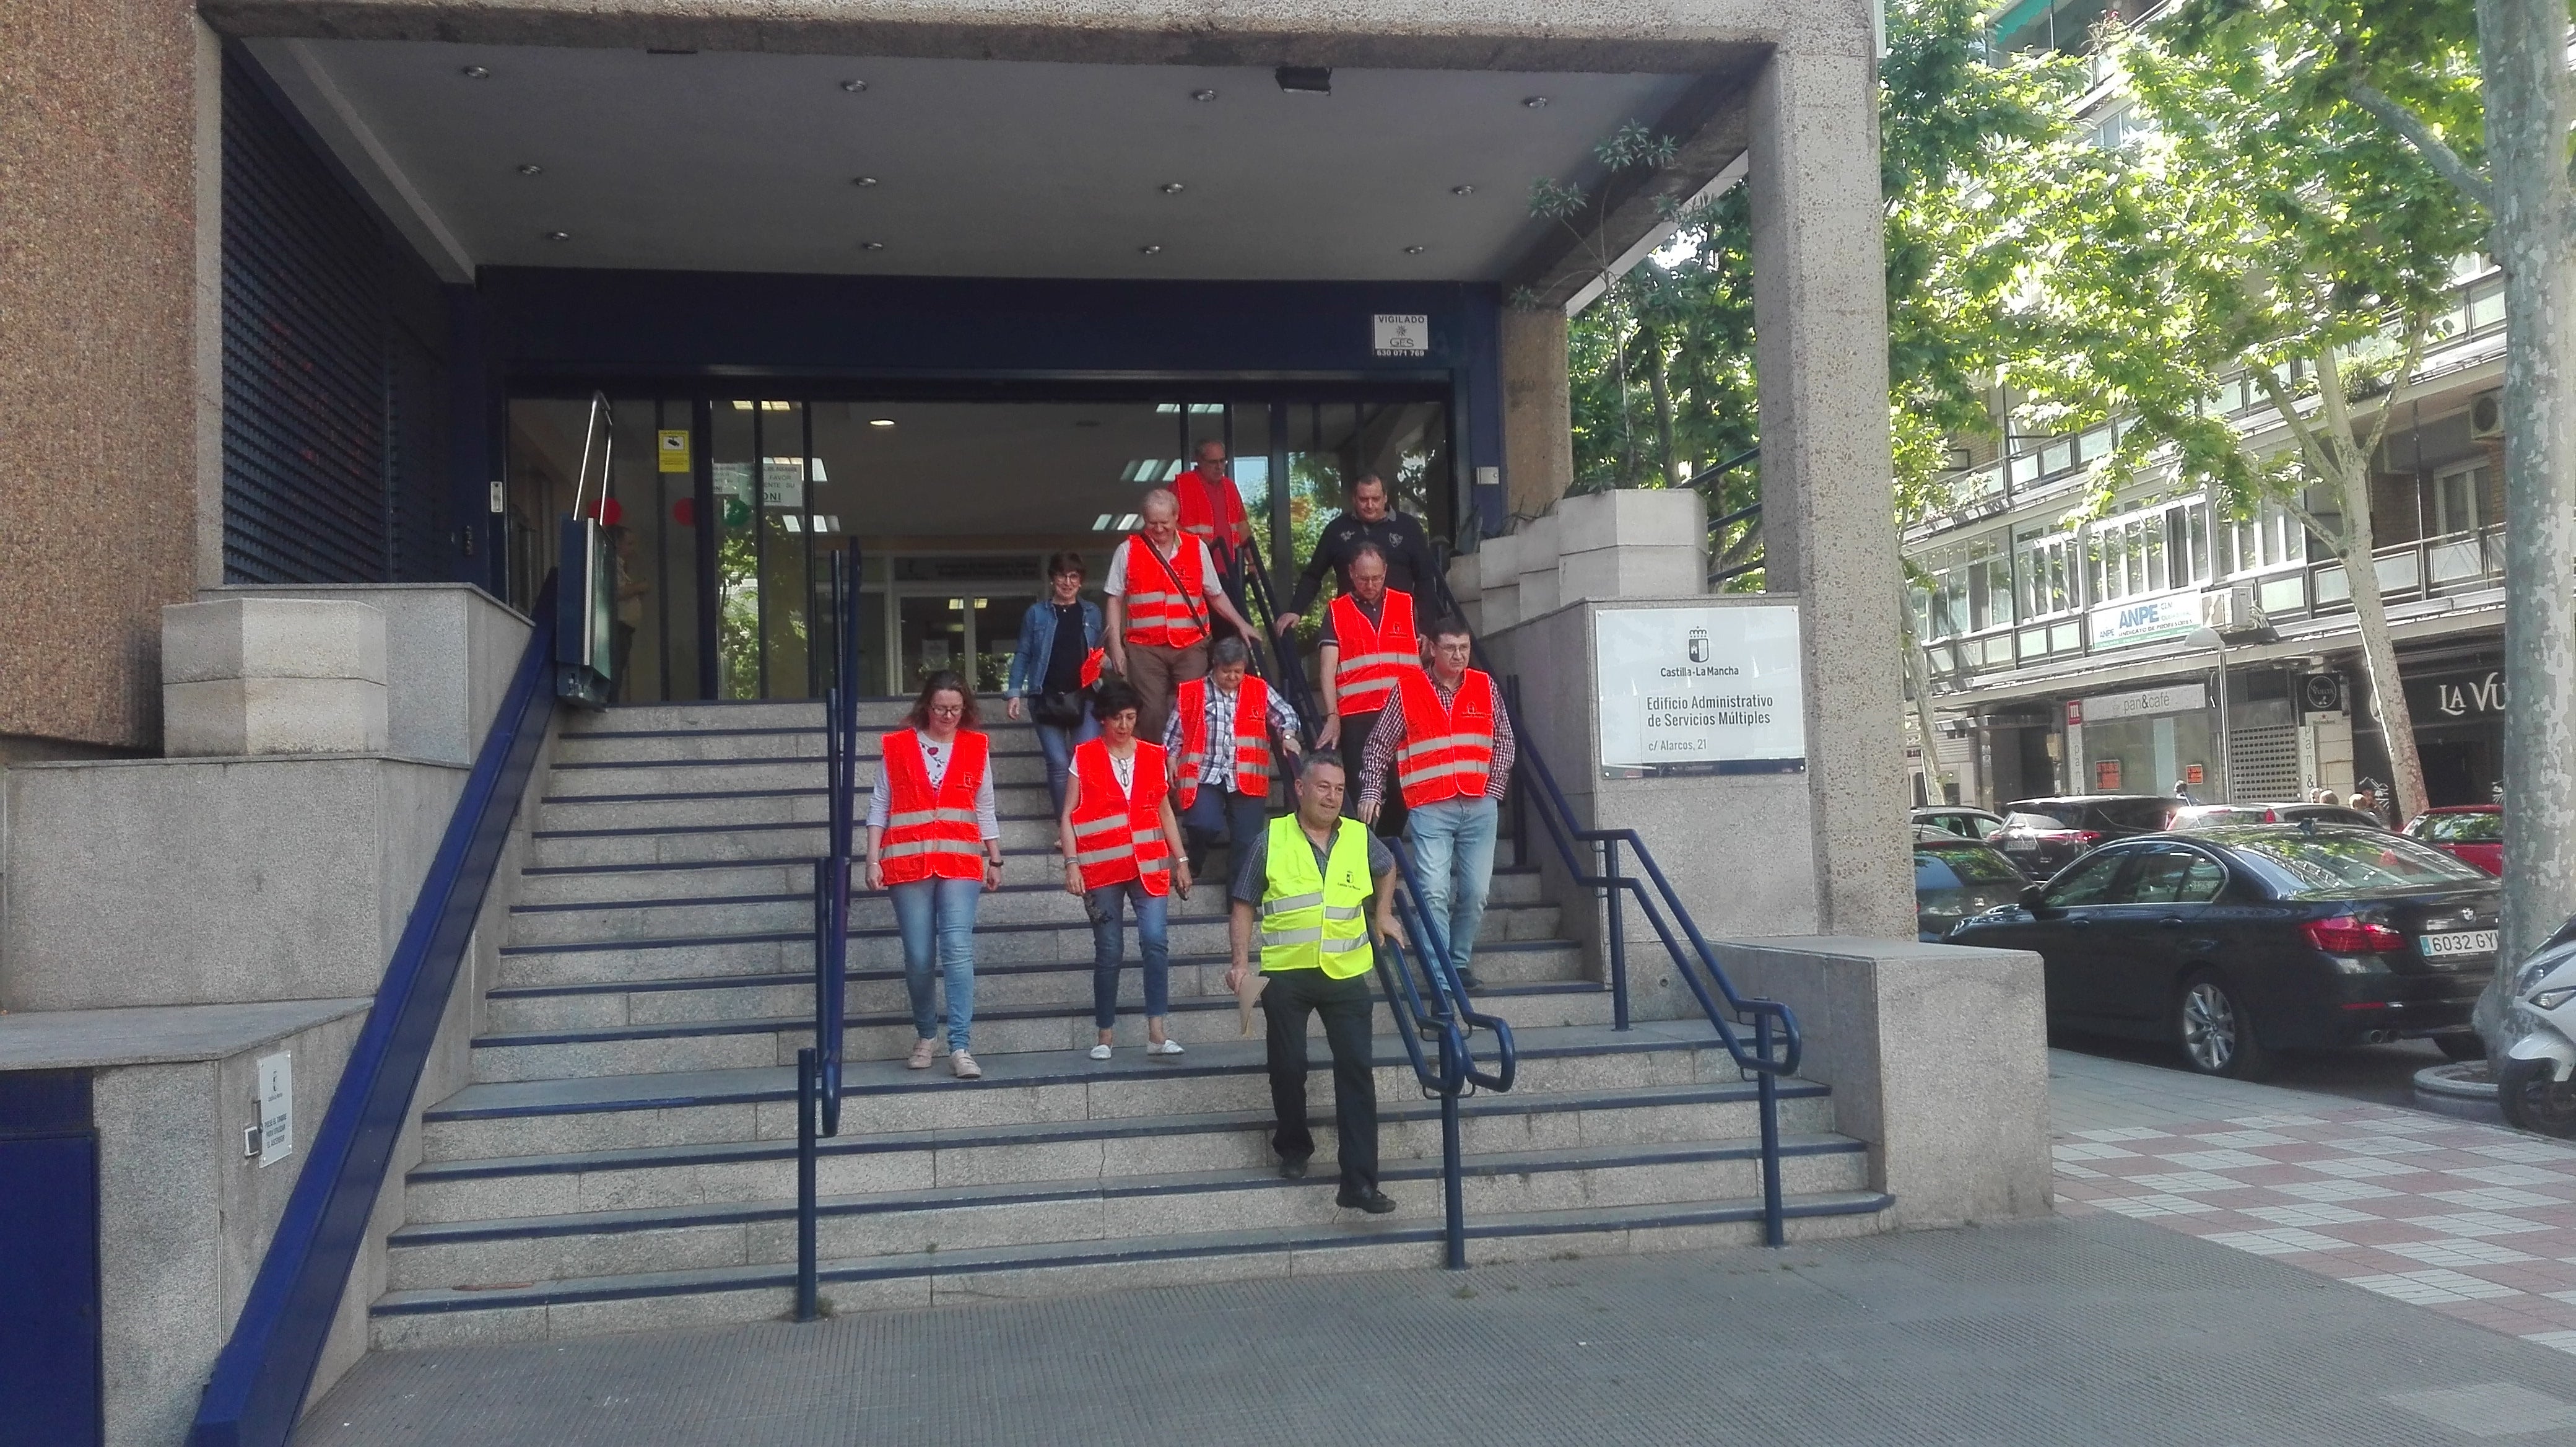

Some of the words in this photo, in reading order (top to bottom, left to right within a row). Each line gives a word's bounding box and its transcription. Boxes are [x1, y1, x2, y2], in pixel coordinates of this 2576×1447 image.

[2119, 603, 2159, 629] ANPE
[2100, 628, 2115, 638] ANPE
[2118, 627, 2147, 637] SINDICATO
[2157, 619, 2193, 629] PROFESORES
[1660, 667, 1706, 677] Castilla-La
[1707, 666, 1739, 676] Mancha
[1647, 697, 1688, 710] Edificio
[1691, 694, 1773, 709] Administrativo
[2440, 684, 2466, 715] LA
[2469, 672, 2505, 711] VU
[2124, 691, 2170, 714] pan&café
[1648, 714, 1661, 728] de
[1664, 713, 1715, 727] Servicios
[1718, 710, 1770, 725] Múltiples
[1648, 740, 1658, 751] c/
[1661, 740, 1695, 751] Alarcos,
[1697, 740, 1707, 750] 21
[2432, 935, 2473, 951] 6032
